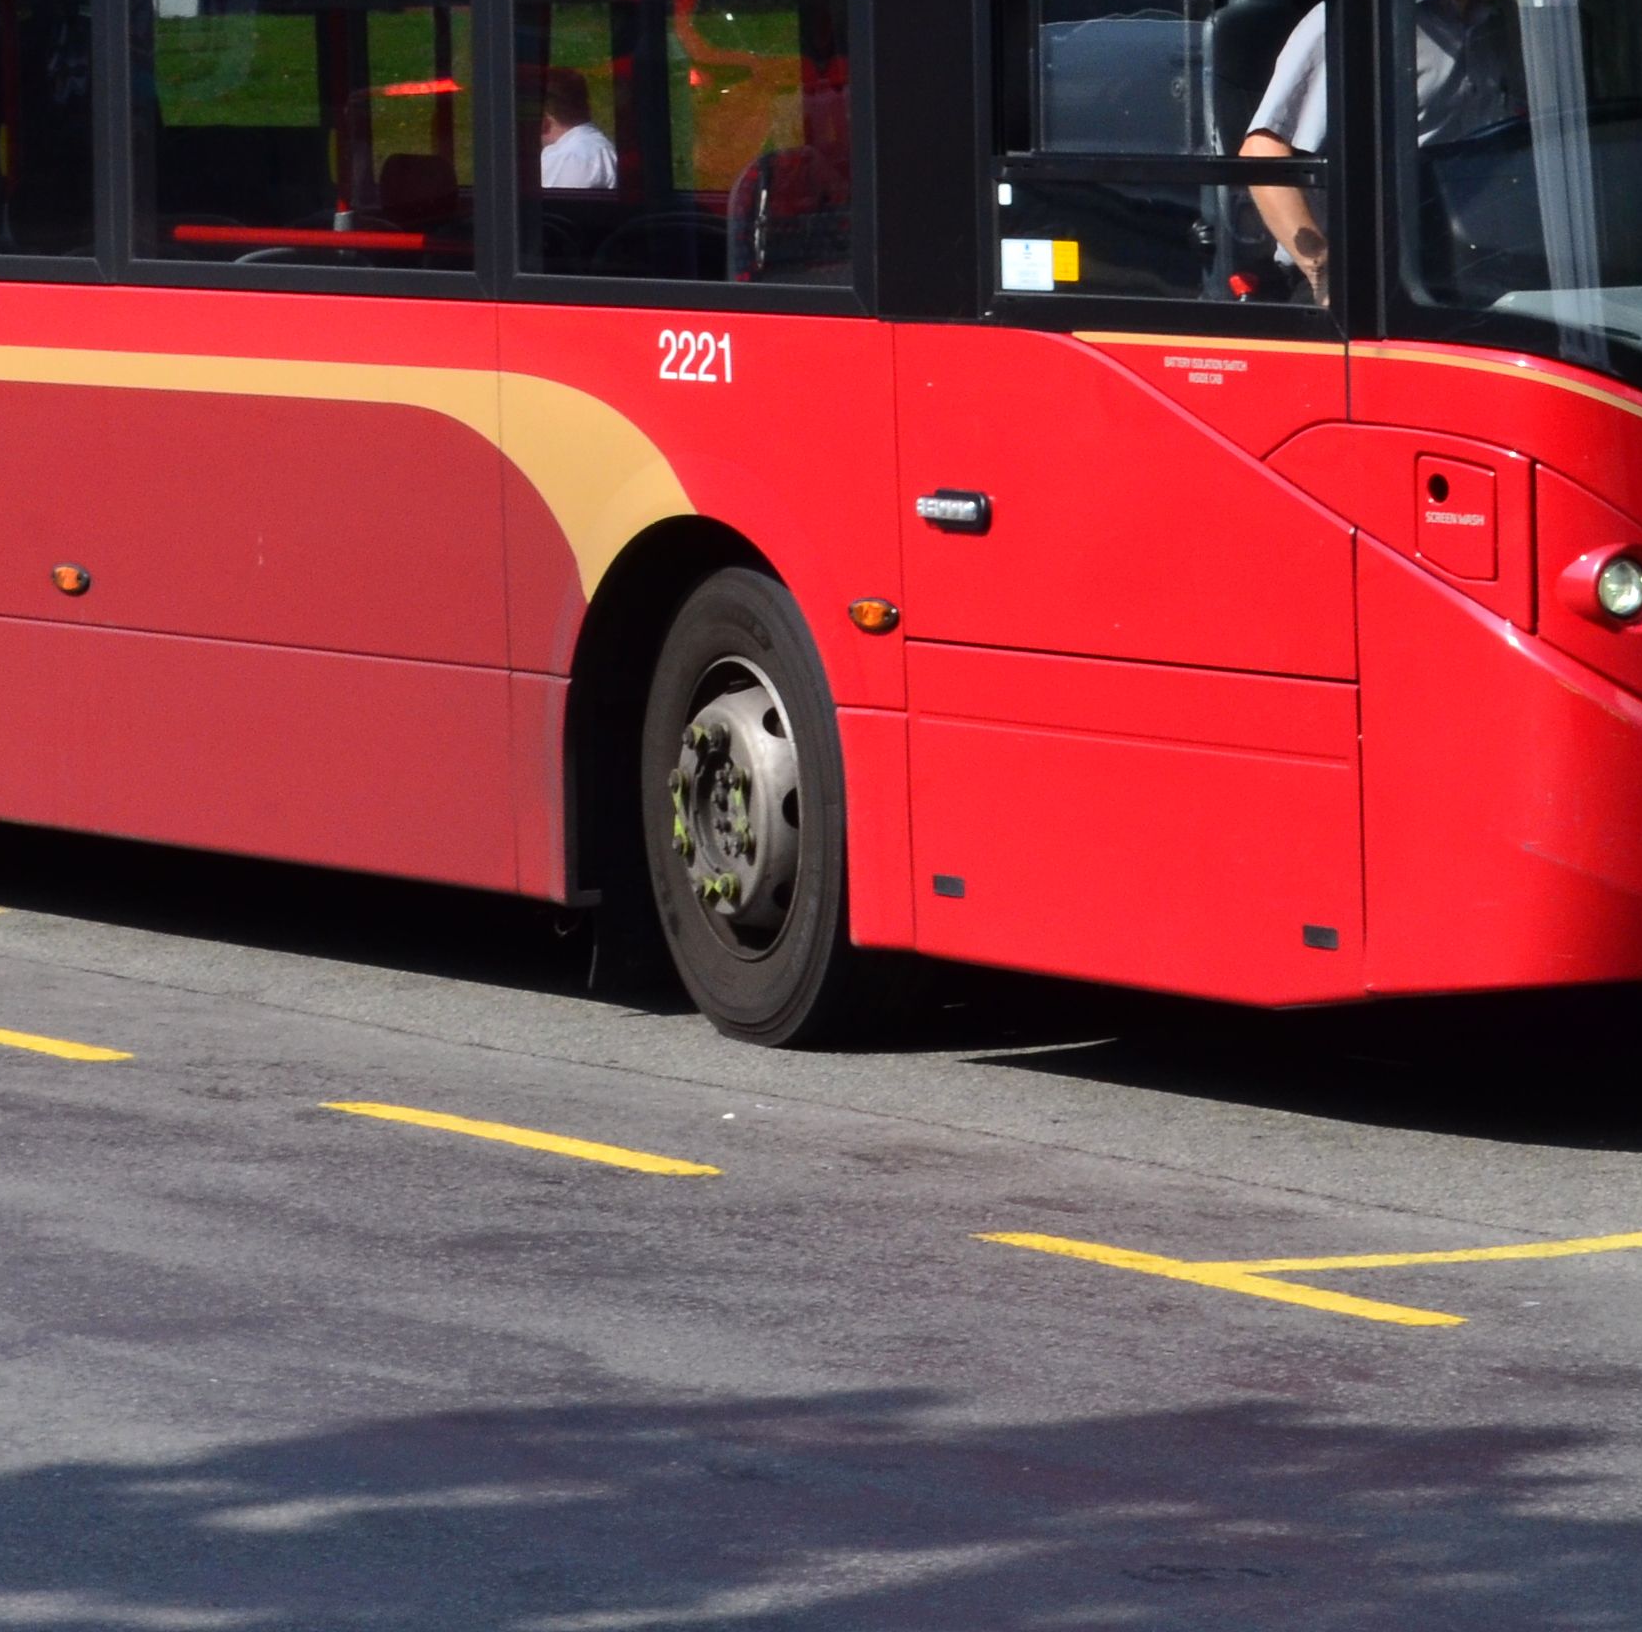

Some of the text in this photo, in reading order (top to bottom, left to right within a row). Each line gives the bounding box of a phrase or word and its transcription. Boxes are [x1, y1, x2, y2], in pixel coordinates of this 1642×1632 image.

[658, 329, 732, 383] 2221
[1425, 511, 1485, 527] SCREEN WASH
